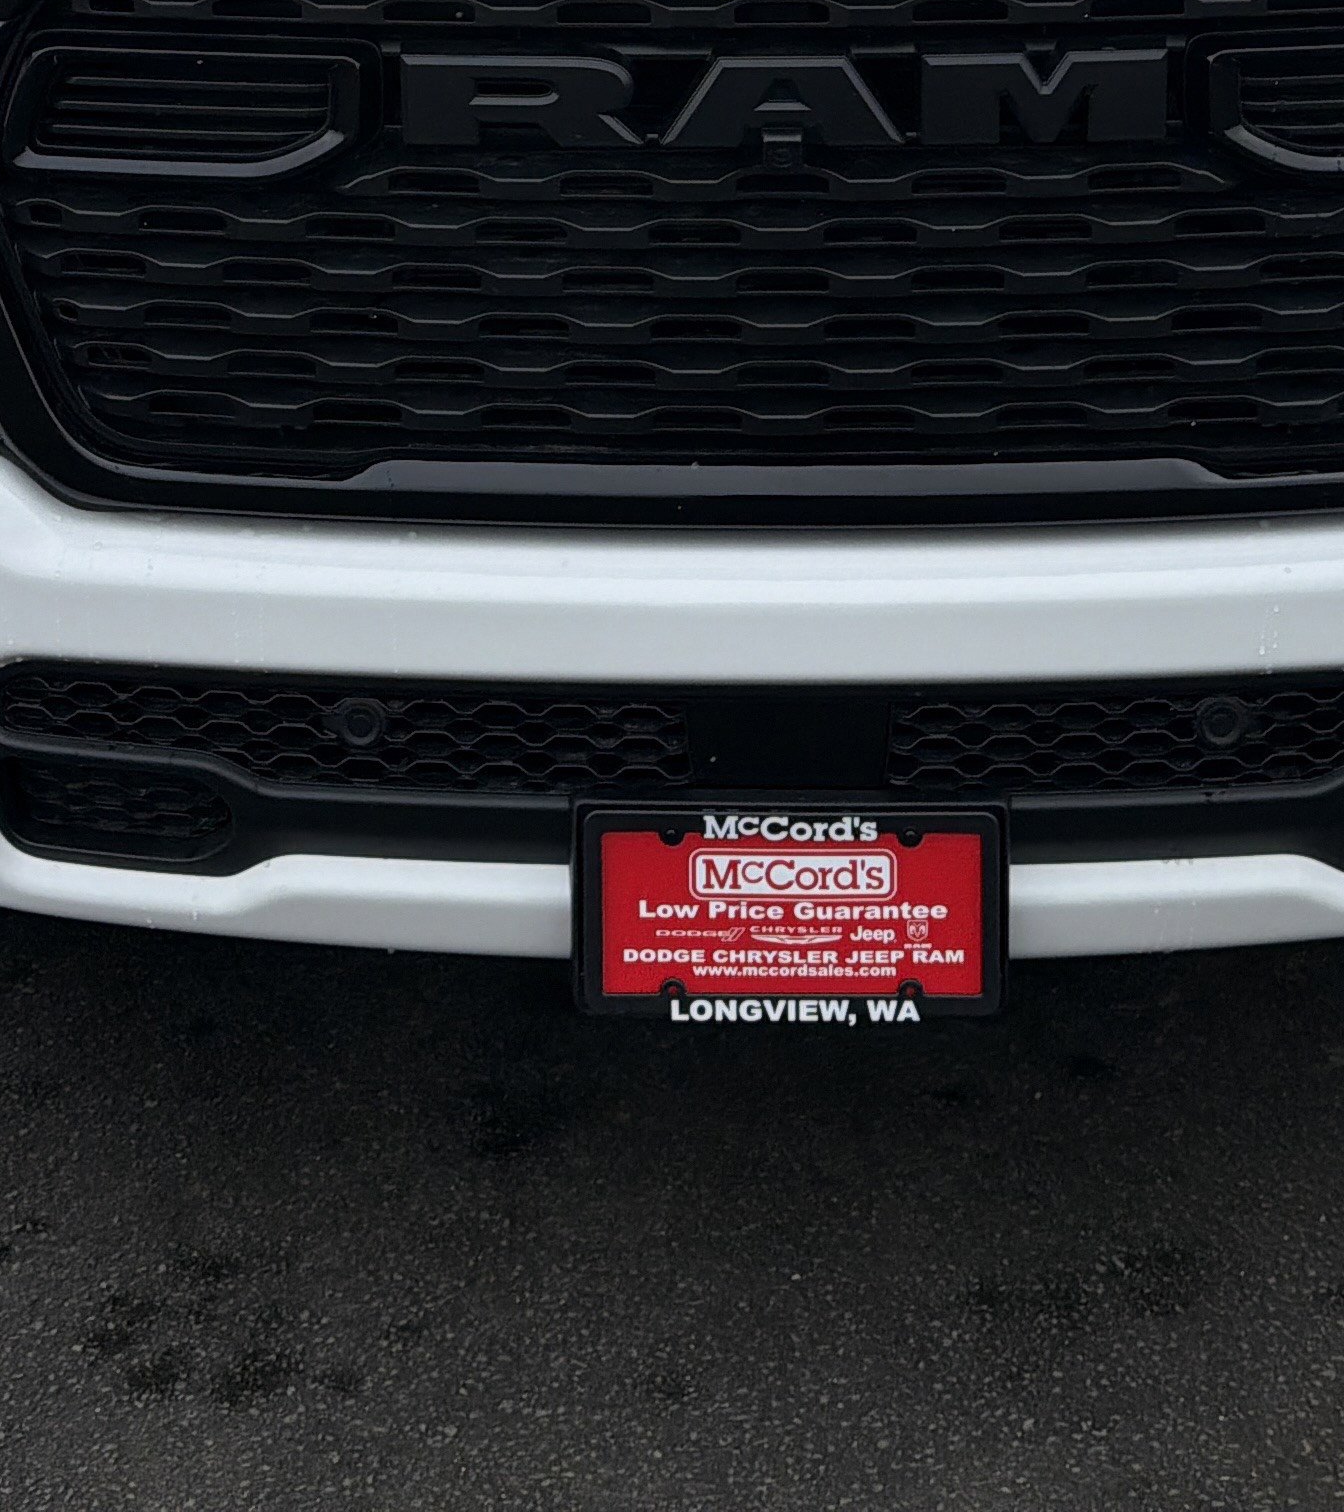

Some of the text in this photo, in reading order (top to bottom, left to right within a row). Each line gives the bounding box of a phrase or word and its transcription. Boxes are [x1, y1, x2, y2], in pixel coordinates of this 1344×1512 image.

[400, 48, 1168, 146] RAM
[703, 815, 878, 842] McCord's
[702, 859, 885, 890] McCord's
[638, 899, 948, 920] Low Price Guarantee
[656, 925, 896, 944] DODGE CHRYSLER Jeep
[623, 948, 965, 964] DODGE CHRYSLER JEEP RAM
[692, 964, 897, 978] www.mccordsales.com
[670, 999, 921, 1027] LONGVIEW, WA
